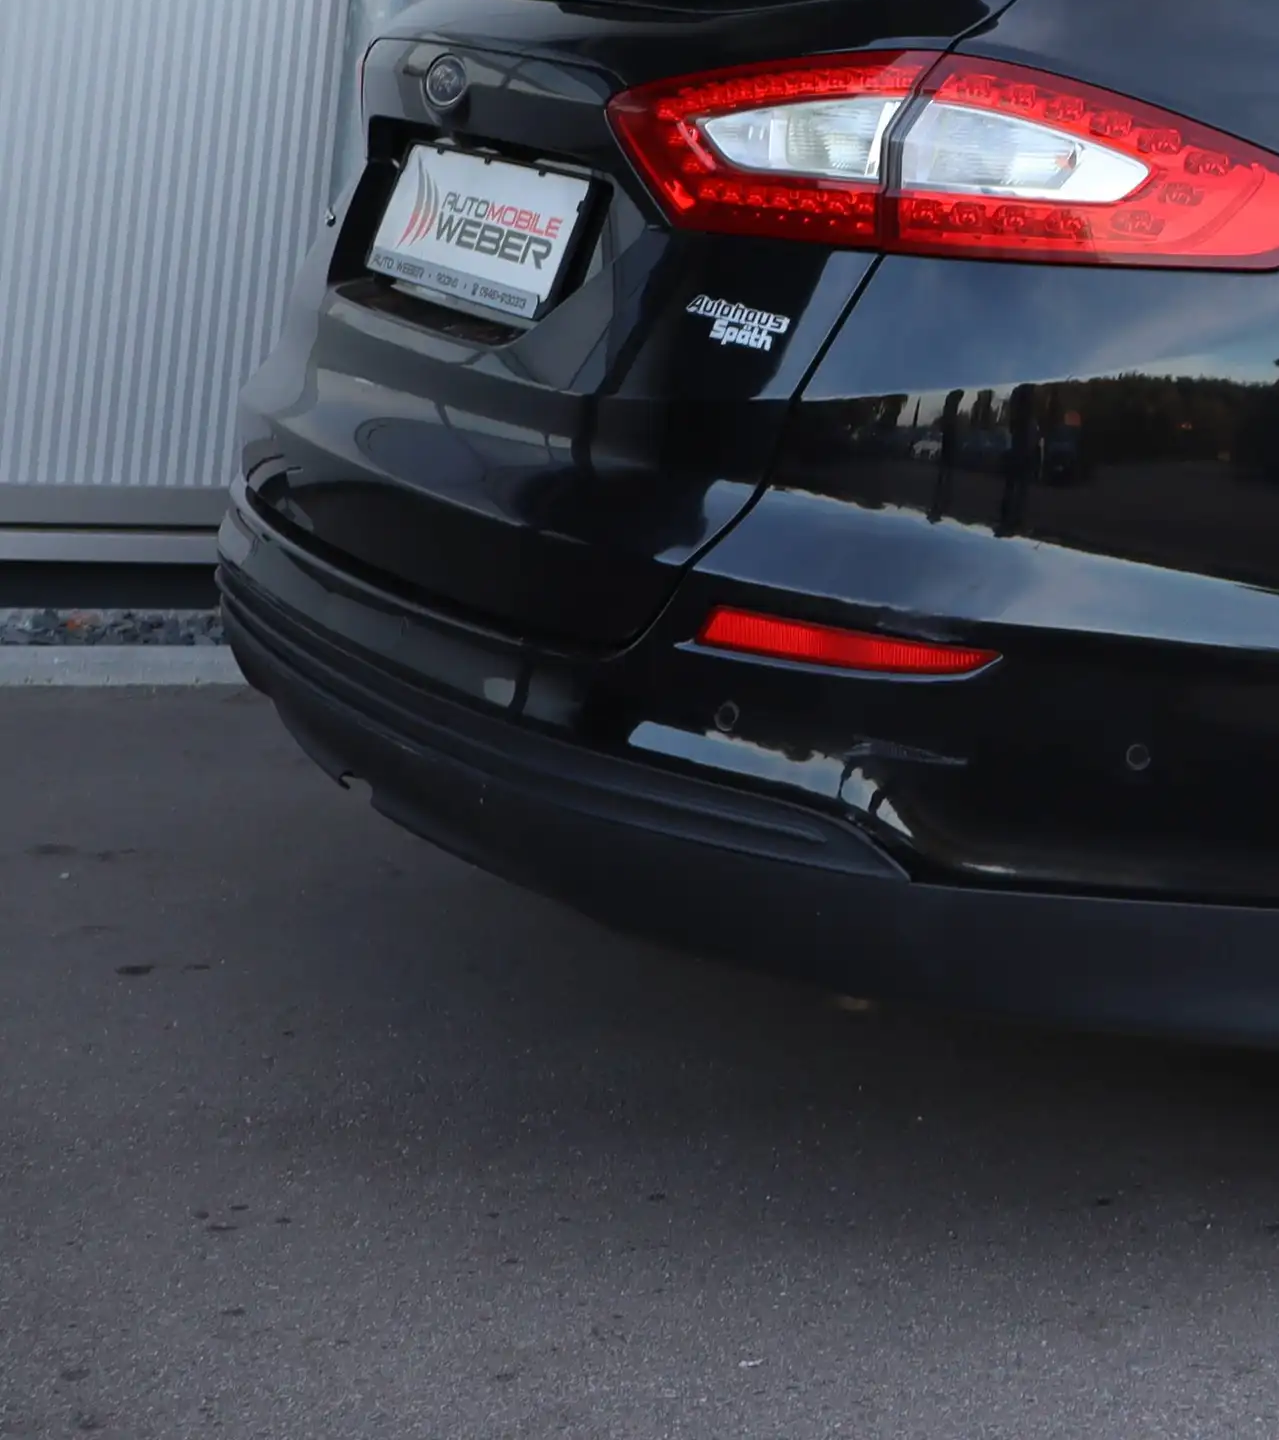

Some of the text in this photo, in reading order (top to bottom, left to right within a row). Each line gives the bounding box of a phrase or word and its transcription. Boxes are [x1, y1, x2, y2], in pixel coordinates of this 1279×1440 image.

[441, 191, 563, 239] AUTOMOBILE
[436, 211, 552, 270] WEBER
[686, 294, 790, 334] Autohaus
[709, 319, 773, 352] Späth
